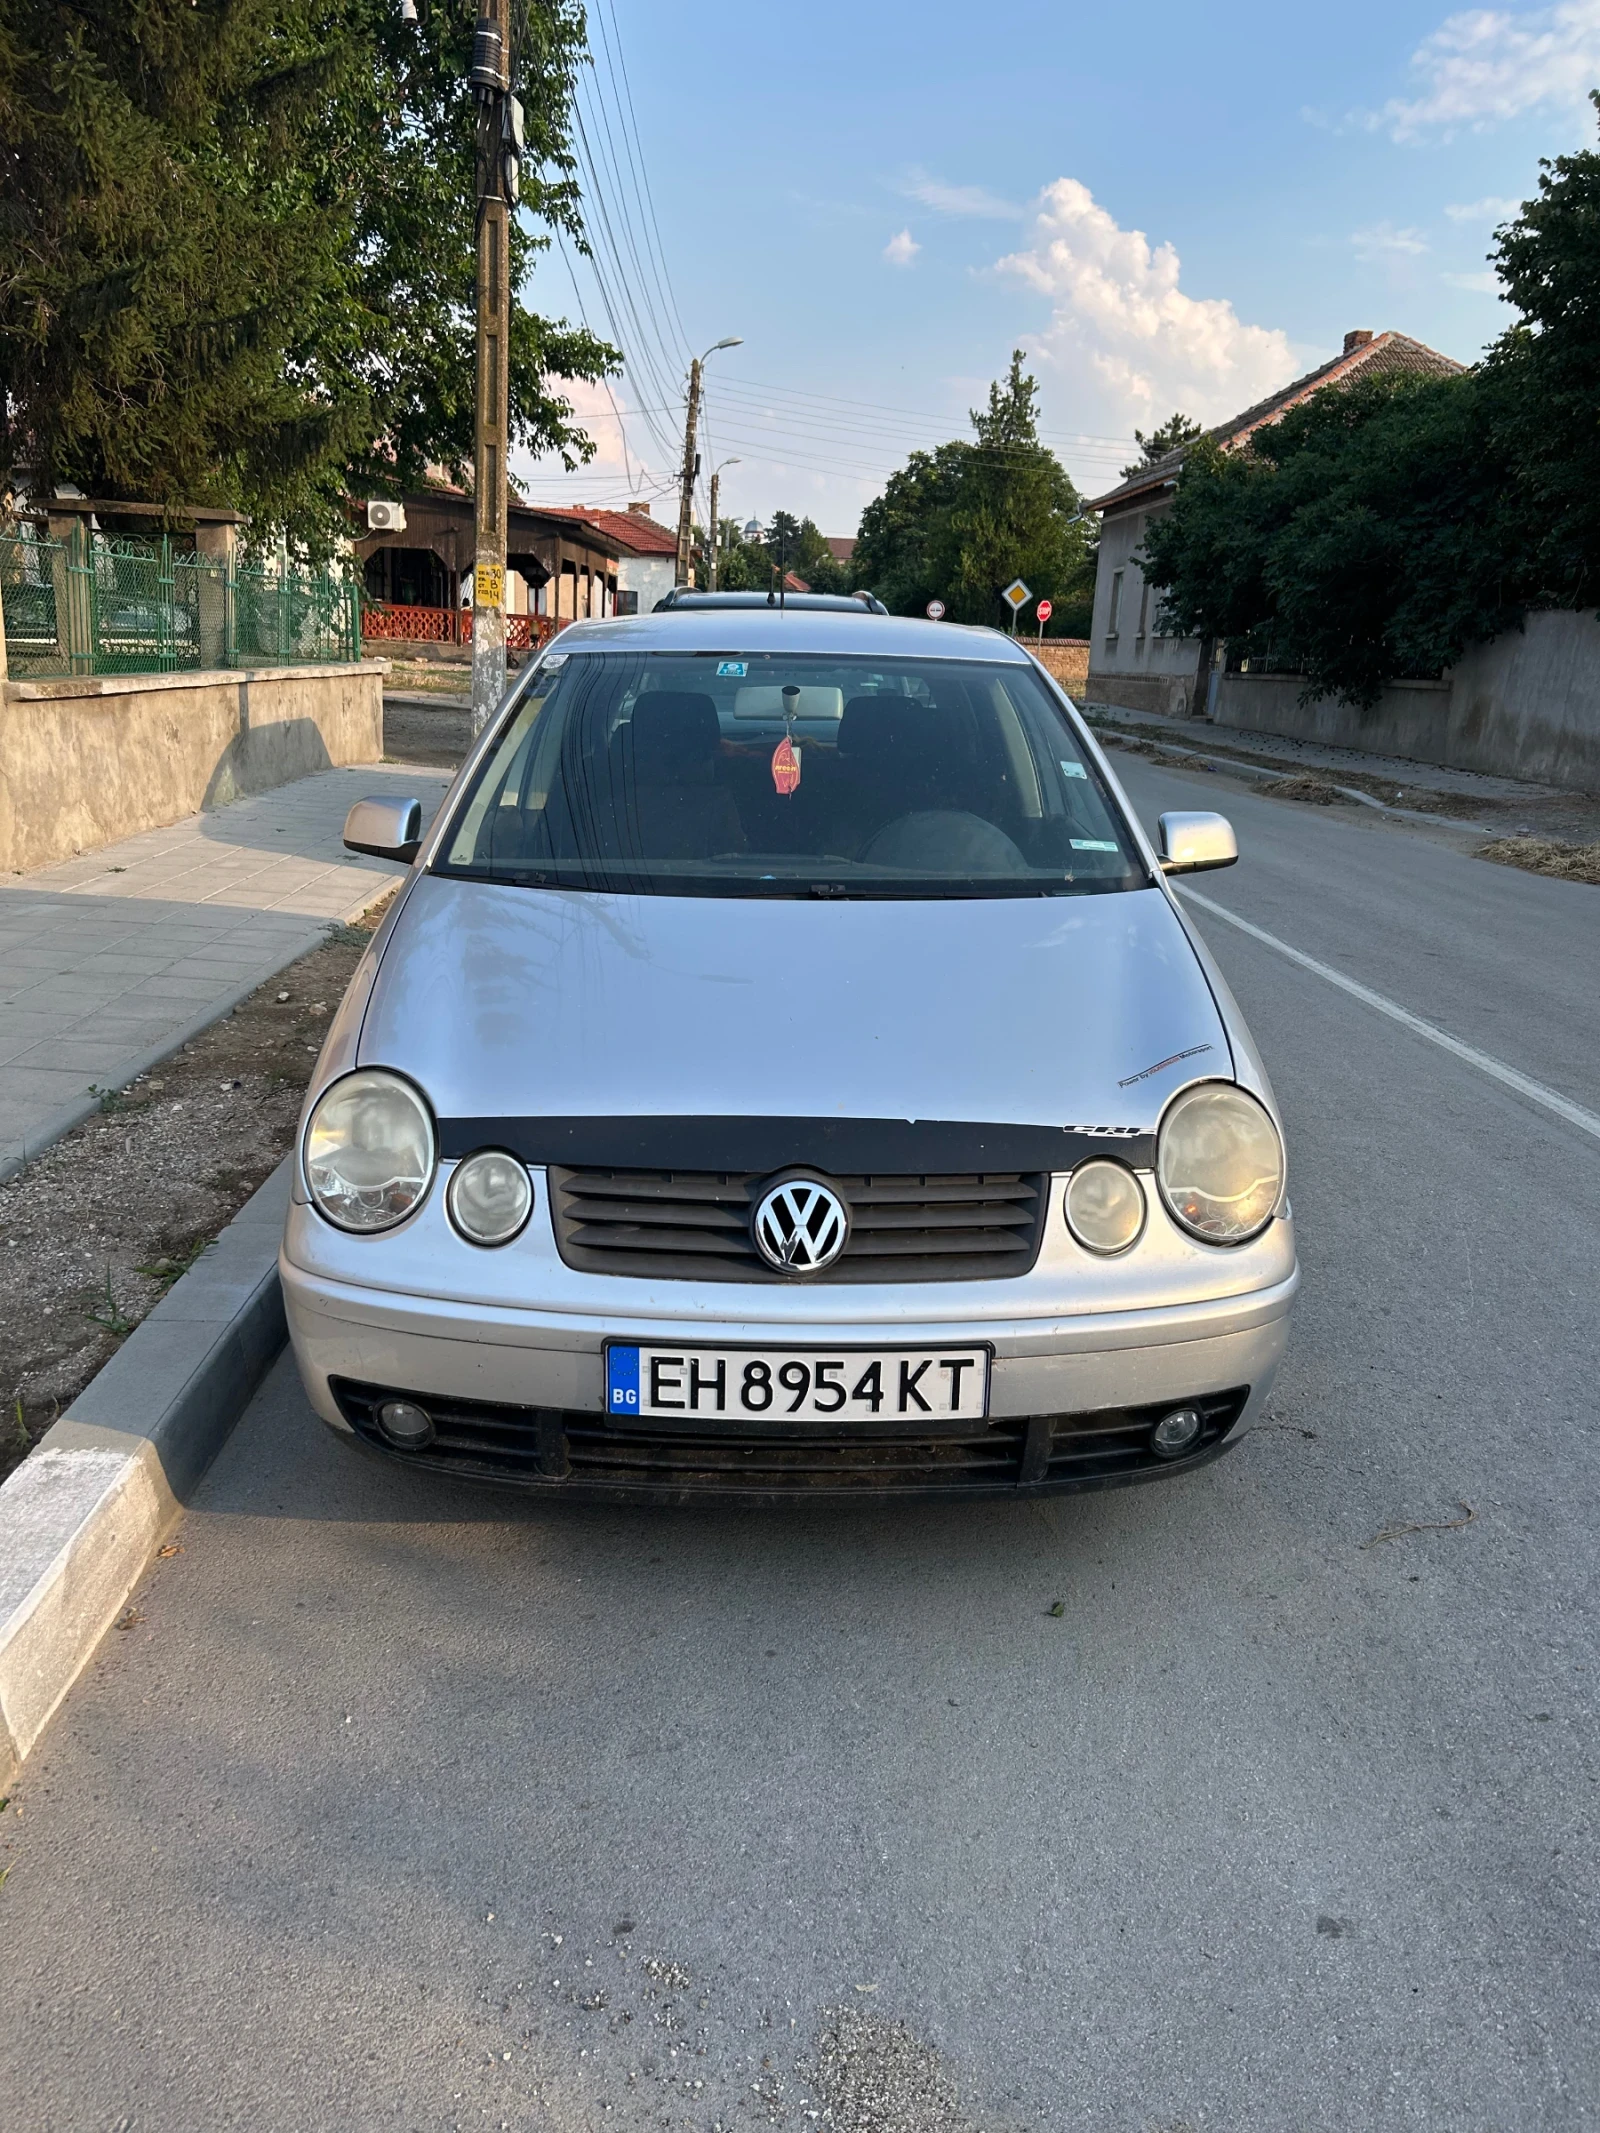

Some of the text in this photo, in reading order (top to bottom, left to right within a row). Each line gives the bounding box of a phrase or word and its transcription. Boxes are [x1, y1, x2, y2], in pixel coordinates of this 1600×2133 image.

[612, 1388, 637, 1405] BG
[650, 1356, 975, 1413] EH 8954 KT
